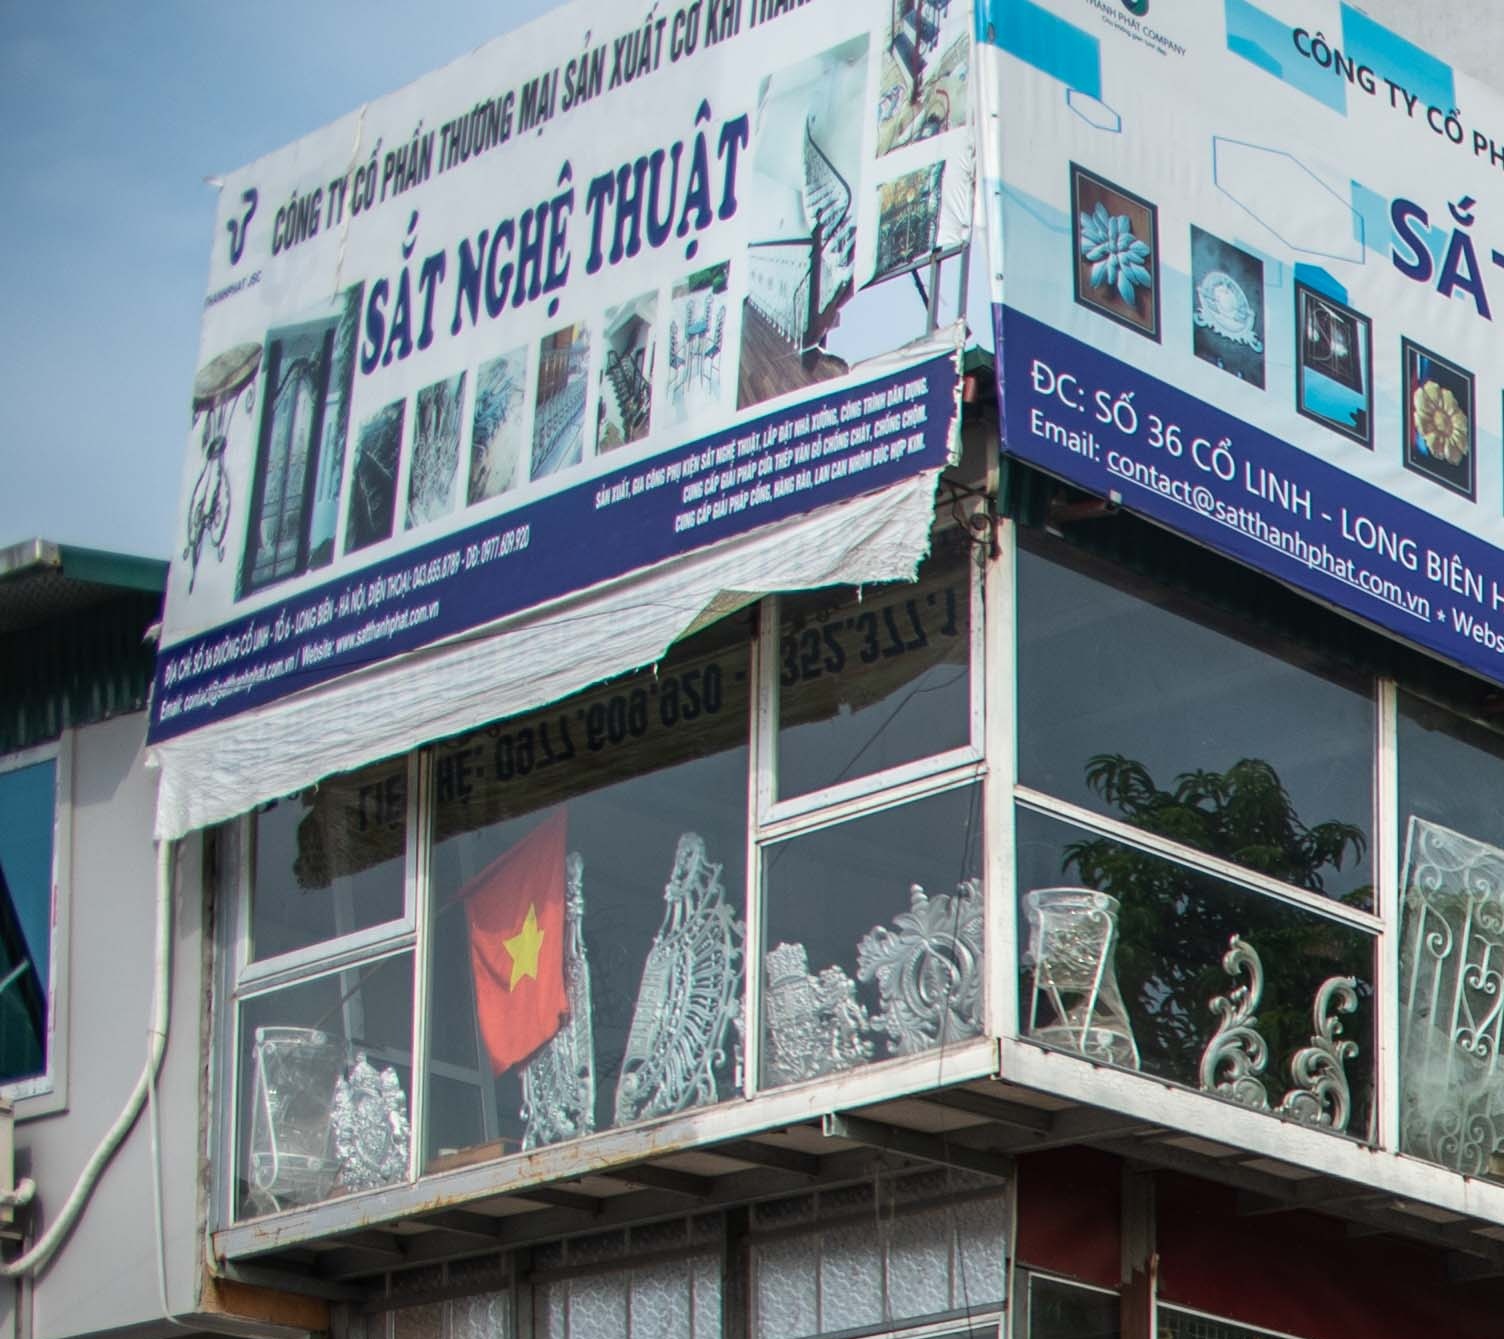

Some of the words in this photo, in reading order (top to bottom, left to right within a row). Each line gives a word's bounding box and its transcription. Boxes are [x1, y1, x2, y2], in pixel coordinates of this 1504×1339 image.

[1142, 26, 1187, 57] COMPANY
[1292, 26, 1376, 95] CÔNG
[1383, 77, 1418, 118] TY
[1426, 105, 1465, 145] CỔ
[271, 187, 323, 257] CÔNG
[326, 173, 350, 230] TY
[380, 119, 436, 203] PHẦN
[438, 88, 515, 175] THƯƠNG
[517, 67, 560, 137] MẠI
[562, 28, 608, 113] SẢN
[608, 2, 667, 91] XUẤT
[360, 208, 447, 376] SẮT
[450, 159, 575, 337] NGHỆ
[585, 97, 751, 276] THUẬT
[645, 466, 666, 491] CÔNG
[666, 461, 682, 484] PHỤ
[700, 445, 716, 471] SẮT
[840, 400, 862, 423] CÔNG
[674, 510, 696, 533] CUNG
[696, 500, 712, 526] CẤP
[728, 486, 750, 514] PHÁP
[814, 463, 831, 485] LAN
[831, 457, 849, 480] CAN
[682, 481, 704, 504] CUNG
[704, 470, 720, 497] CẤP
[736, 461, 758, 485] PHÁP
[1030, 358, 1085, 412] ĐC:
[1094, 390, 1138, 435] SỐ
[1148, 414, 1183, 457] 36
[1191, 436, 1236, 482] CỔ
[1245, 461, 1312, 520] LINH
[1341, 507, 1418, 572] LONG
[1427, 553, 1484, 604] BIÊN
[1030, 408, 1101, 463] Email:
[1107, 450, 1431, 621] contact@satthanhphat.com.vn
[295, 606, 317, 635] LONG
[317, 596, 335, 626] BIÊN
[338, 586, 350, 618] HÀ
[367, 575, 387, 609] ĐIỆN
